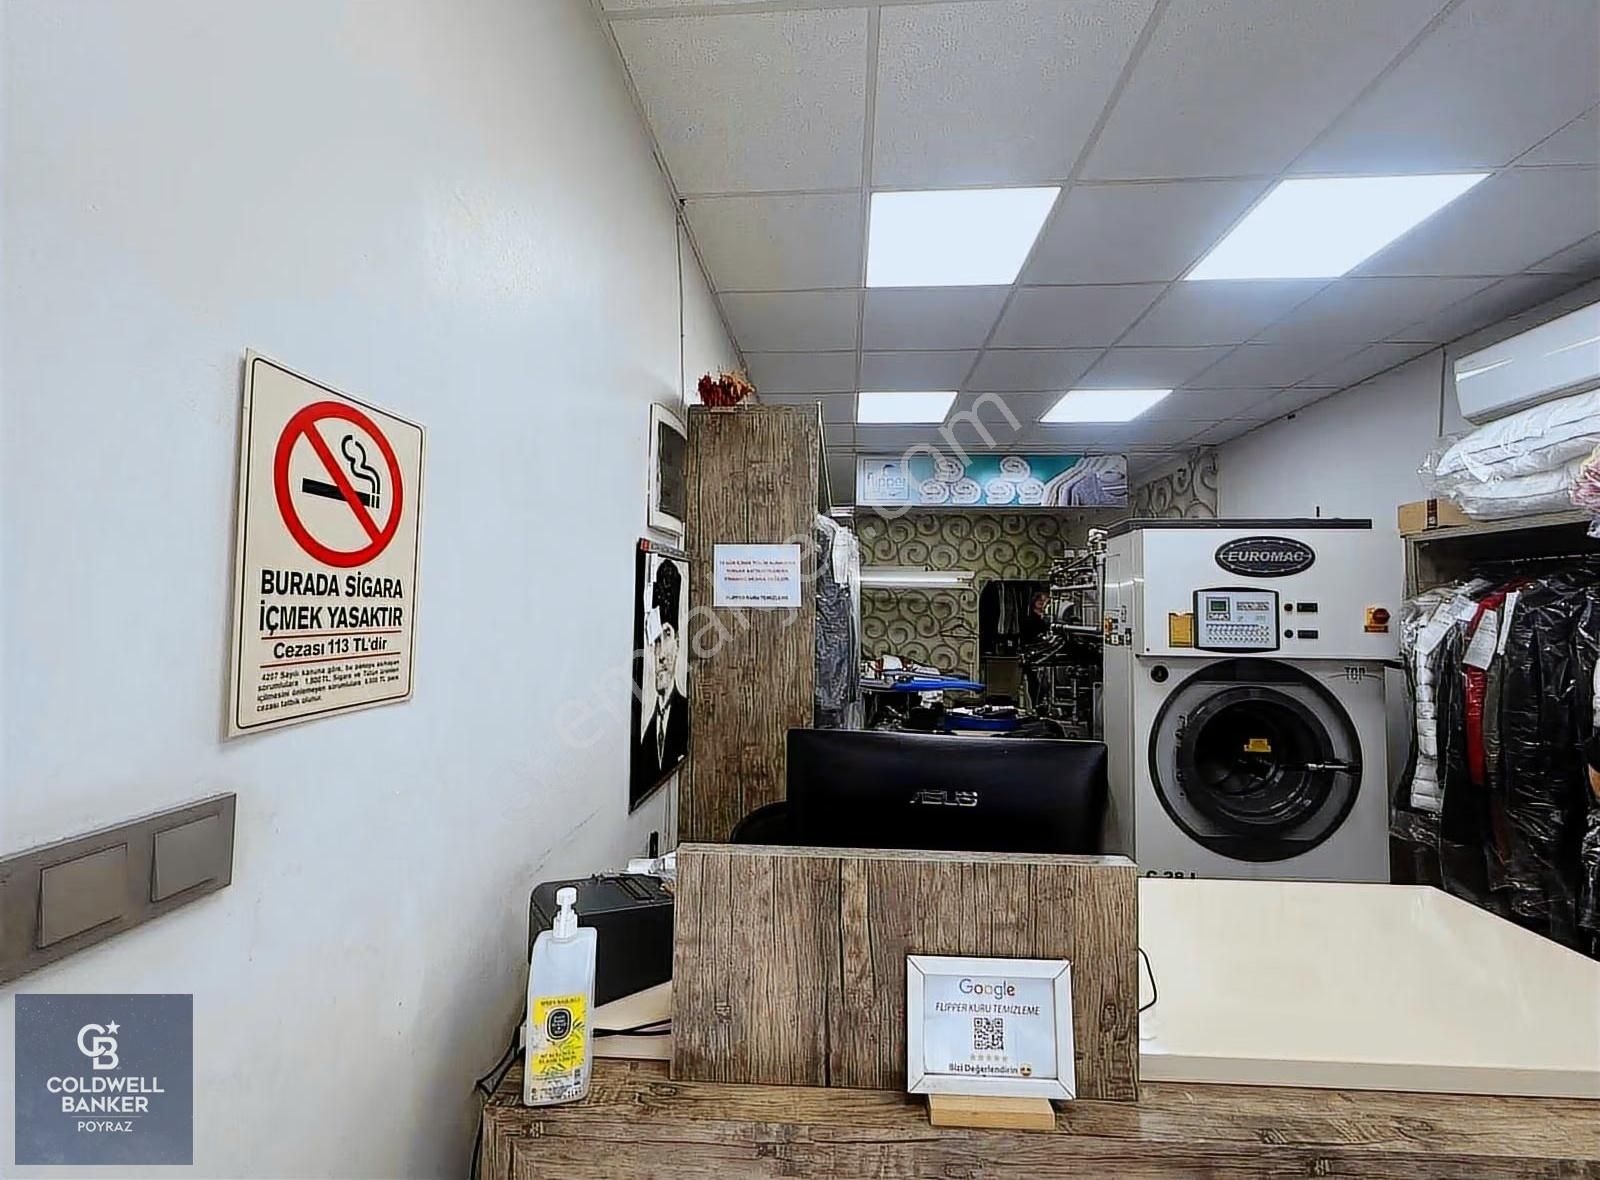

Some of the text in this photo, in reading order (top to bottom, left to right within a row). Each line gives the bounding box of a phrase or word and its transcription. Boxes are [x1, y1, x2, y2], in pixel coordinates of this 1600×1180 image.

[1227, 550, 1304, 563] EUROMAC
[261, 569, 403, 599] BURADA SİGARA
[259, 600, 403, 636] İÇMEK YASAKTIR
[273, 635, 387, 659] Cezası 113 TL'dir
[908, 789, 978, 807] ASUS
[959, 978, 1015, 1000] Google
[969, 1003, 991, 1013] KURU
[965, 1063, 1018, 1074] Değerlendirin
